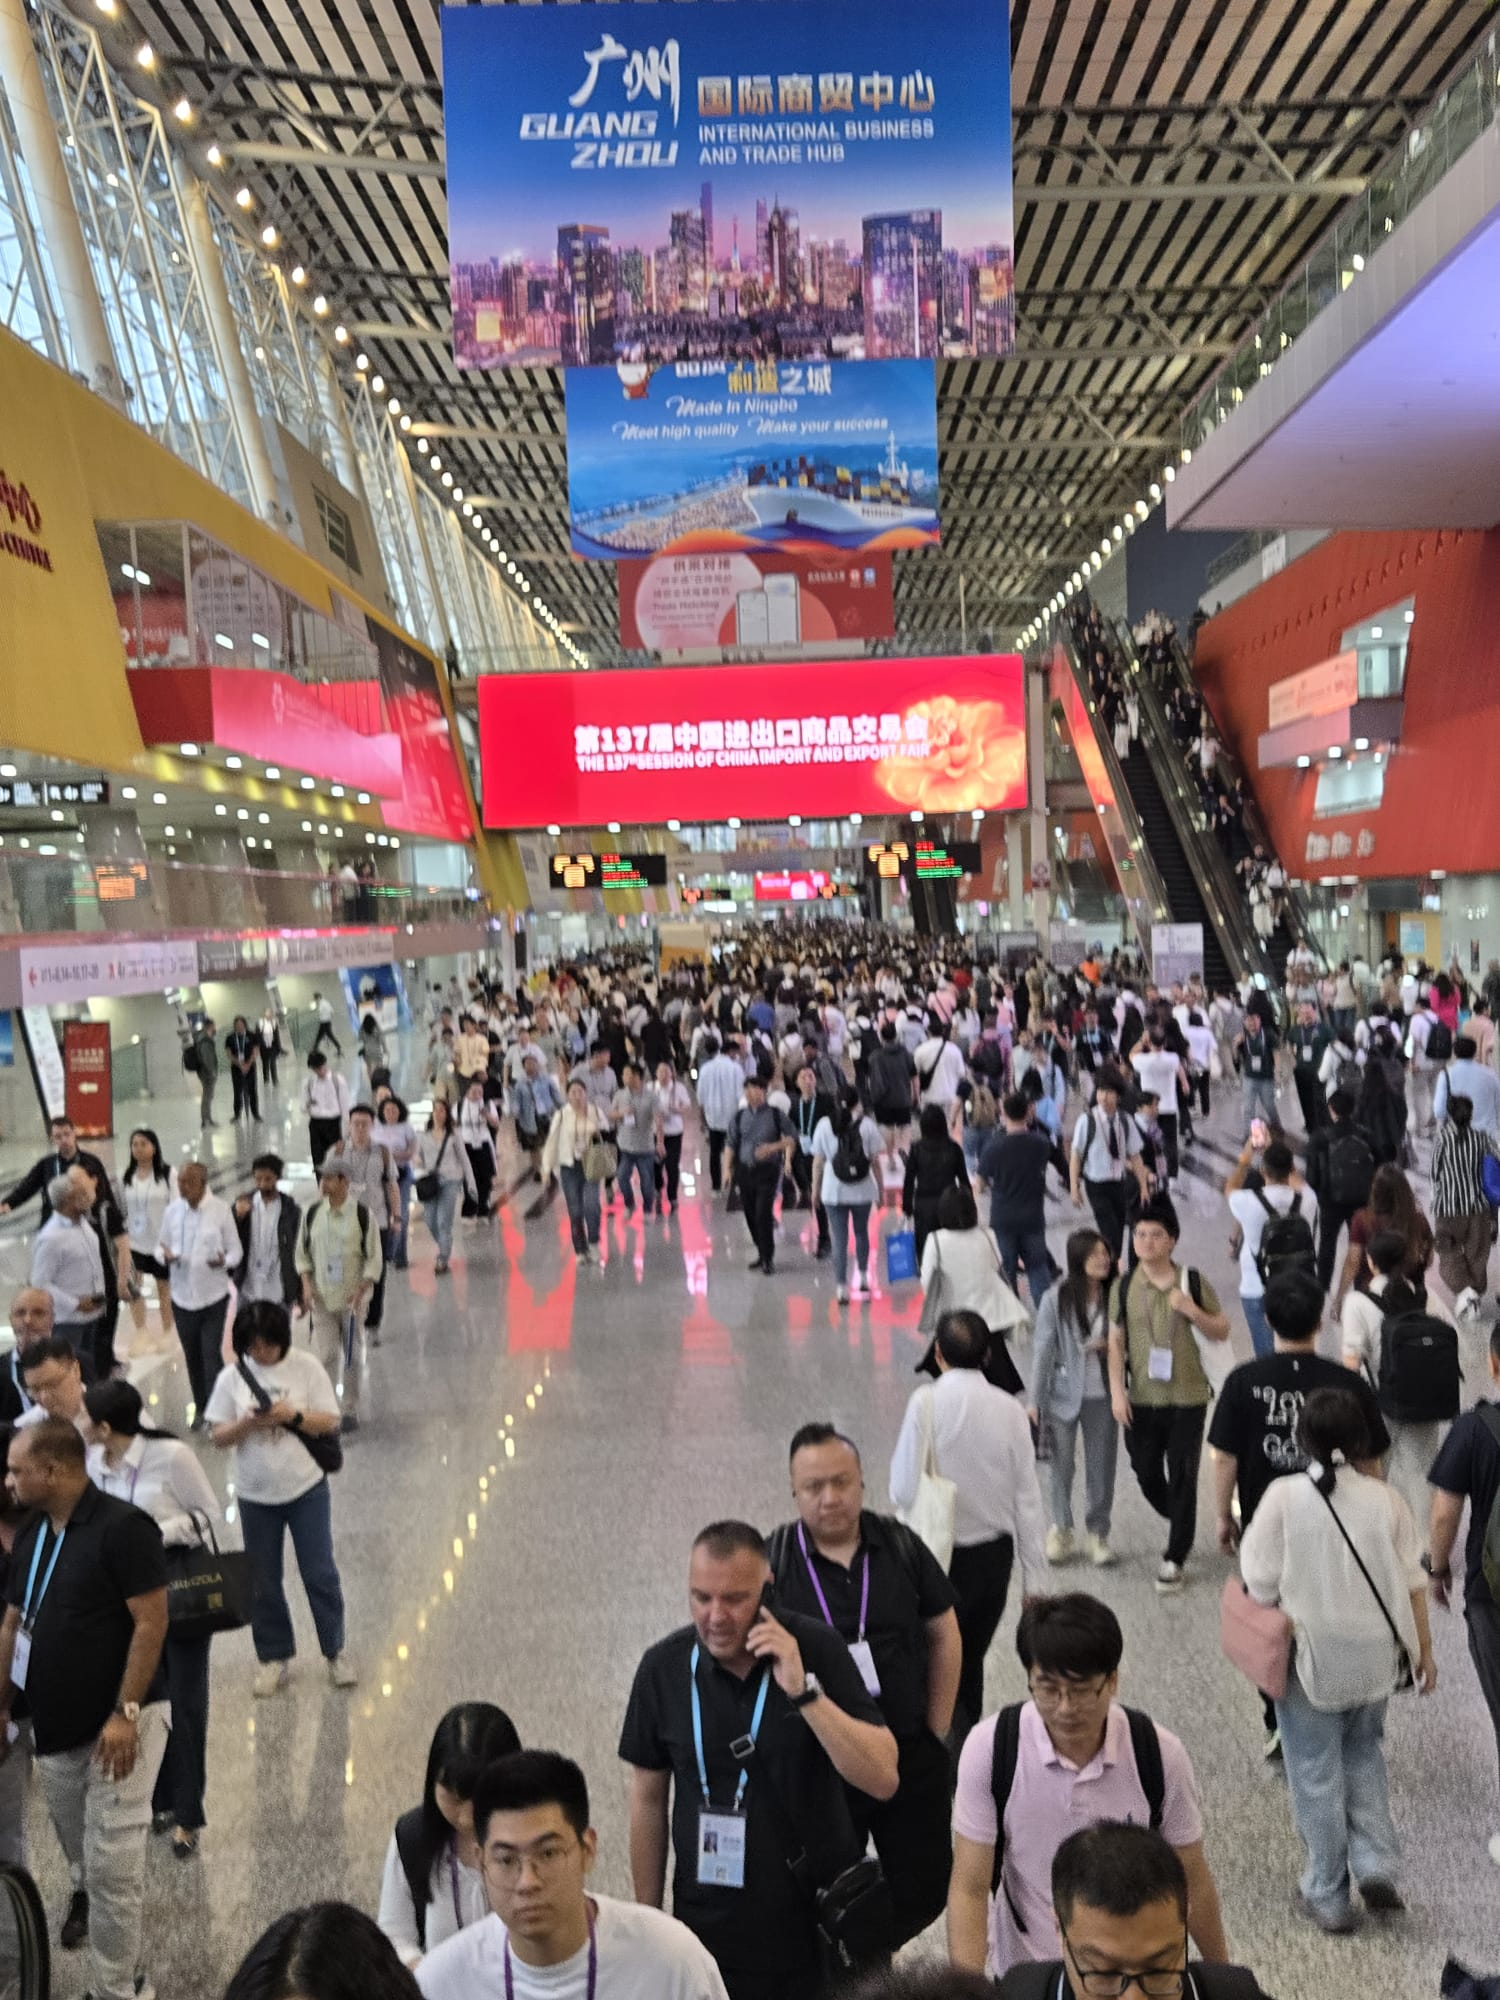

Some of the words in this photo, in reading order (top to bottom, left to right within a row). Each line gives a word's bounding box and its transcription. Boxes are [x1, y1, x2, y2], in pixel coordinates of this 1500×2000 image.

[568, 33, 681, 128] 广州
[697, 69, 935, 116] 国际商贸中心
[519, 110, 658, 140] GUANG
[699, 120, 841, 144] INTERNATIONAL
[845, 118, 934, 141] BUSINESS
[570, 140, 679, 168] ZHOU
[699, 146, 738, 165] AND
[742, 144, 803, 164] TRADE
[807, 143, 845, 163] HUB
[666, 396, 723, 417] Made
[745, 397, 798, 417] Ningbo
[612, 420, 658, 441] Meet
[661, 420, 690, 440] high
[695, 419, 739, 440] quality
[748, 415, 797, 436] Make
[800, 418, 830, 435] your
[834, 417, 888, 431] success
[574, 713, 929, 755] 第137届中国进出口商品交易会
[576, 754, 606, 772] THE
[636, 751, 694, 770] SESSION
[695, 750, 714, 768] OF
[715, 748, 759, 767] CHINA
[759, 746, 812, 765] IMPORT
[813, 745, 843, 763] AND
[844, 743, 896, 762] EXPORT
[900, 742, 930, 758] FAIR
